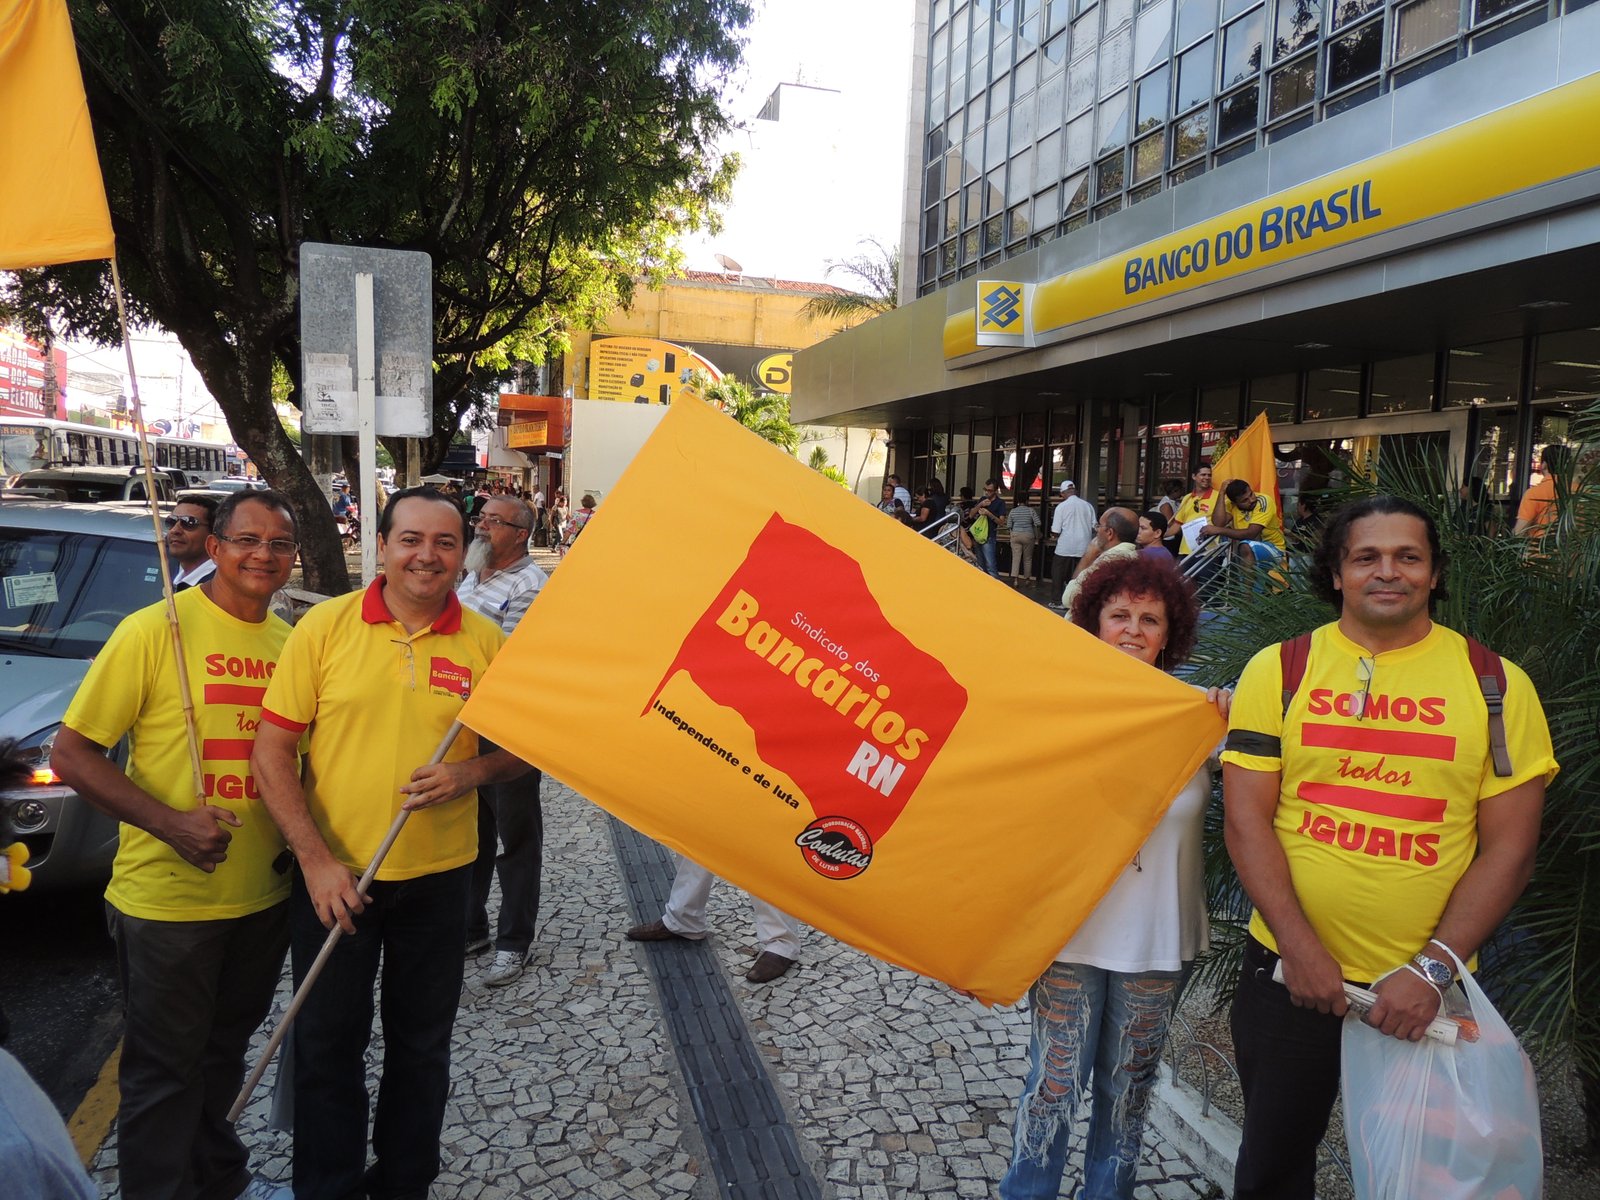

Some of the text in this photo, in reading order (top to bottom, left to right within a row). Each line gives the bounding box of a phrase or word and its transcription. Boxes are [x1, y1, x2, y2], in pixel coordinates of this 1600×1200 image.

[1123, 180, 1382, 295] BANCO DO BRASIL
[11, 367, 28, 387] DOS
[715, 588, 930, 761] Bancários
[790, 611, 880, 683] Sindicato dos
[1307, 688, 1446, 726] SOMOS
[653, 699, 800, 809] Independente e de luta
[846, 740, 907, 797] RN
[1336, 756, 1412, 787] todos
[204, 773, 262, 800] IGU
[811, 854, 840, 872] DE LUTAS
[1296, 810, 1441, 867] IGUAIS
